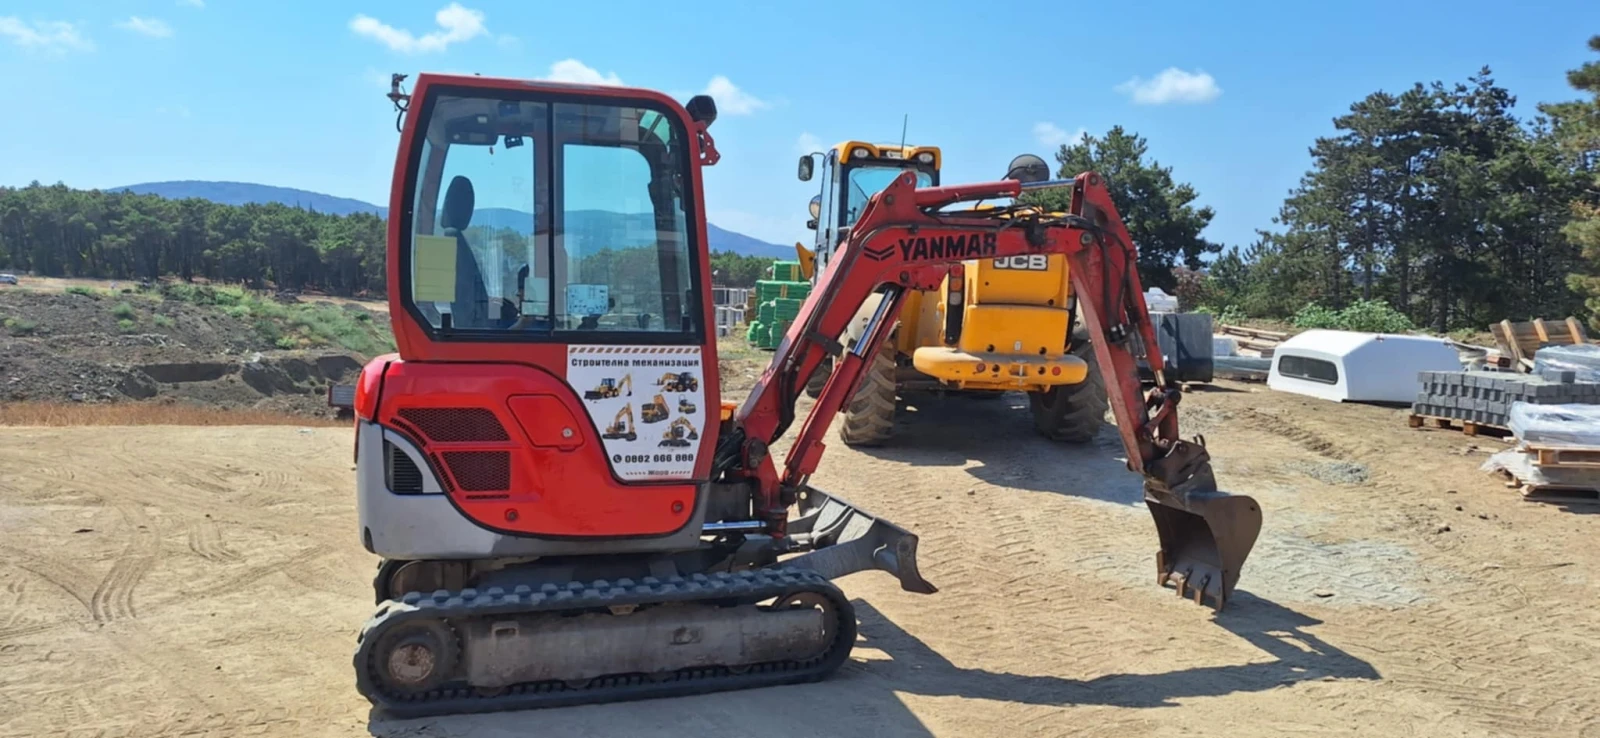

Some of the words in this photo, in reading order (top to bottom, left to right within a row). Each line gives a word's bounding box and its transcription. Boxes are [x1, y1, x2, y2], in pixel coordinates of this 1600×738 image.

[898, 232, 997, 261] YANMAR
[994, 255, 1047, 270] JCB
[571, 358, 629, 367] Строителна
[632, 358, 699, 367] механизация
[653, 454, 672, 462] 666
